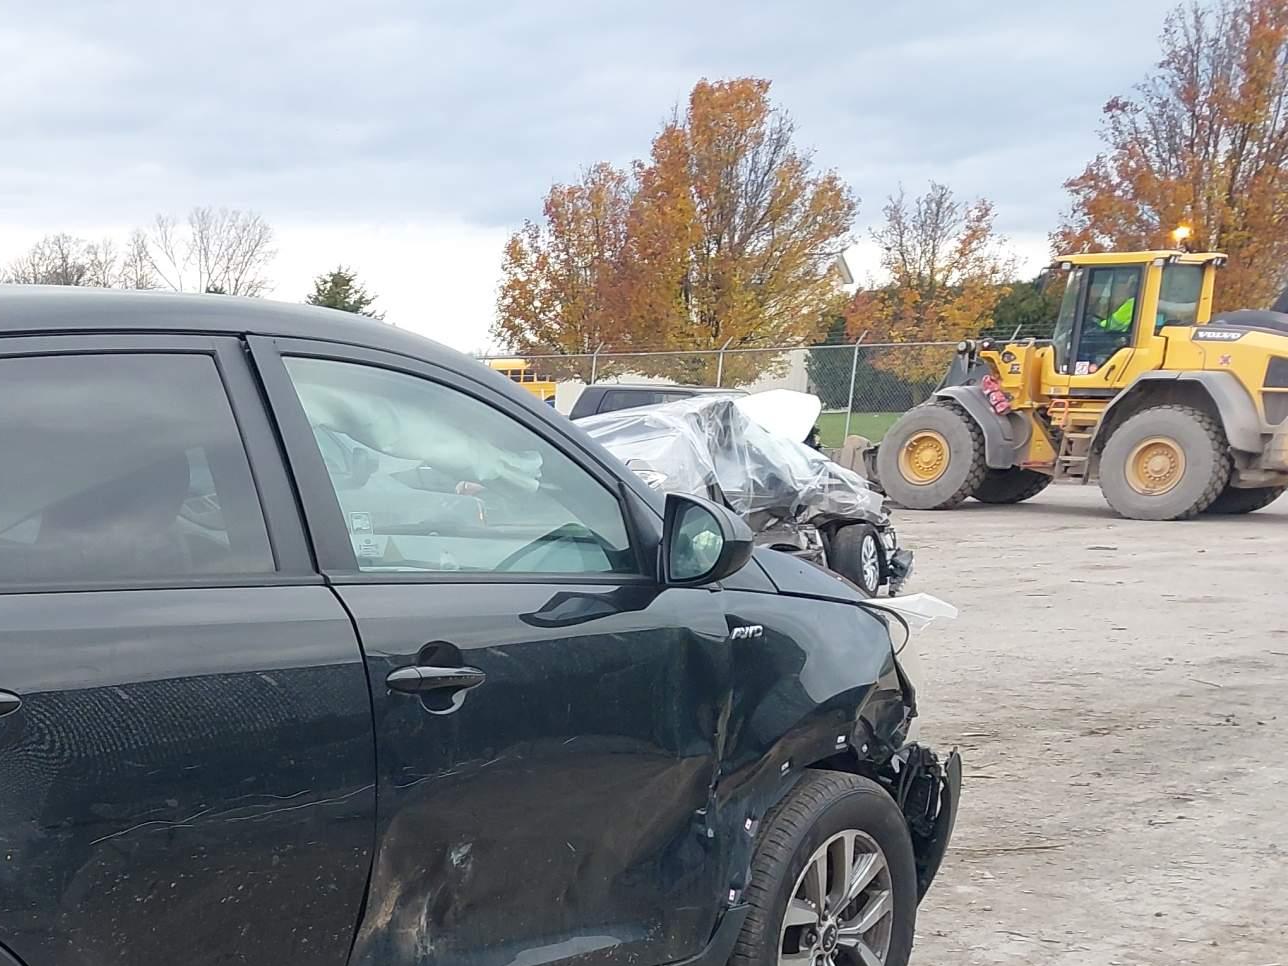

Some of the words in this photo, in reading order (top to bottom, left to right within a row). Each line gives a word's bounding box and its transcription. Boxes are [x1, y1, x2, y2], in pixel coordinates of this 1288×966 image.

[1197, 331, 1242, 340] VOLVO
[731, 625, 764, 640] AWD
[824, 927, 836, 949] KIA
